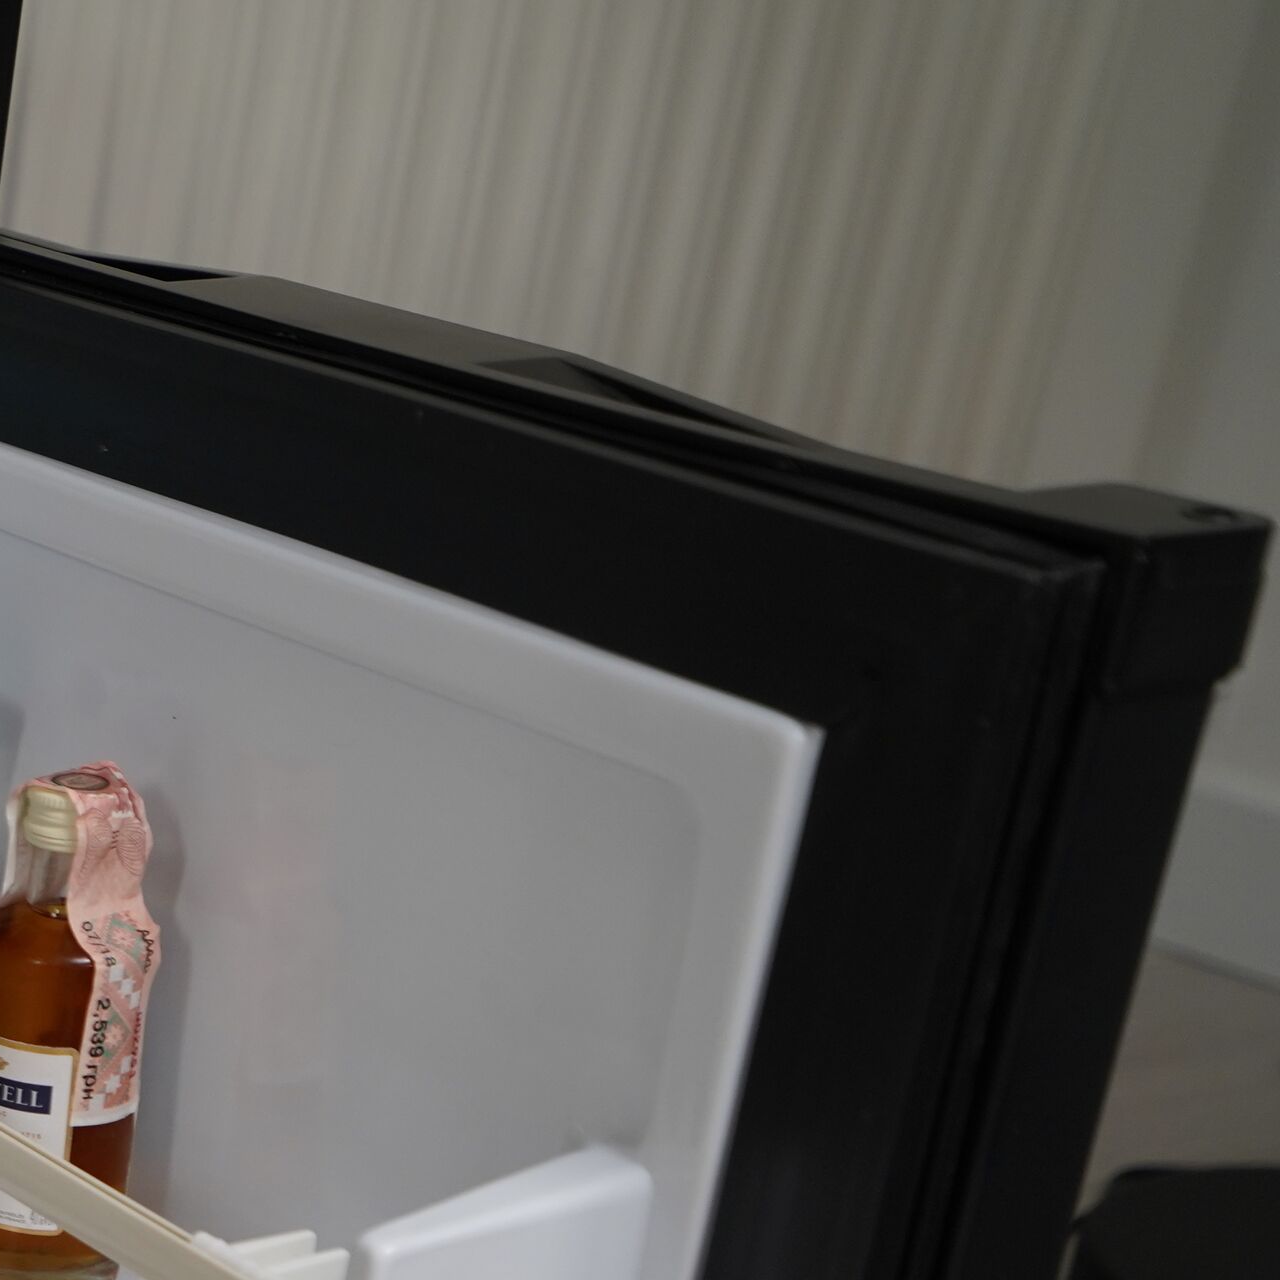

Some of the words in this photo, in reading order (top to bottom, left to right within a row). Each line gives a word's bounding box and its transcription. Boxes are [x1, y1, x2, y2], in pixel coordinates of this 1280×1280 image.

[81, 920, 117, 967] 07/18
[89, 997, 111, 1058] 2,539
[81, 1063, 100, 1101] грн
